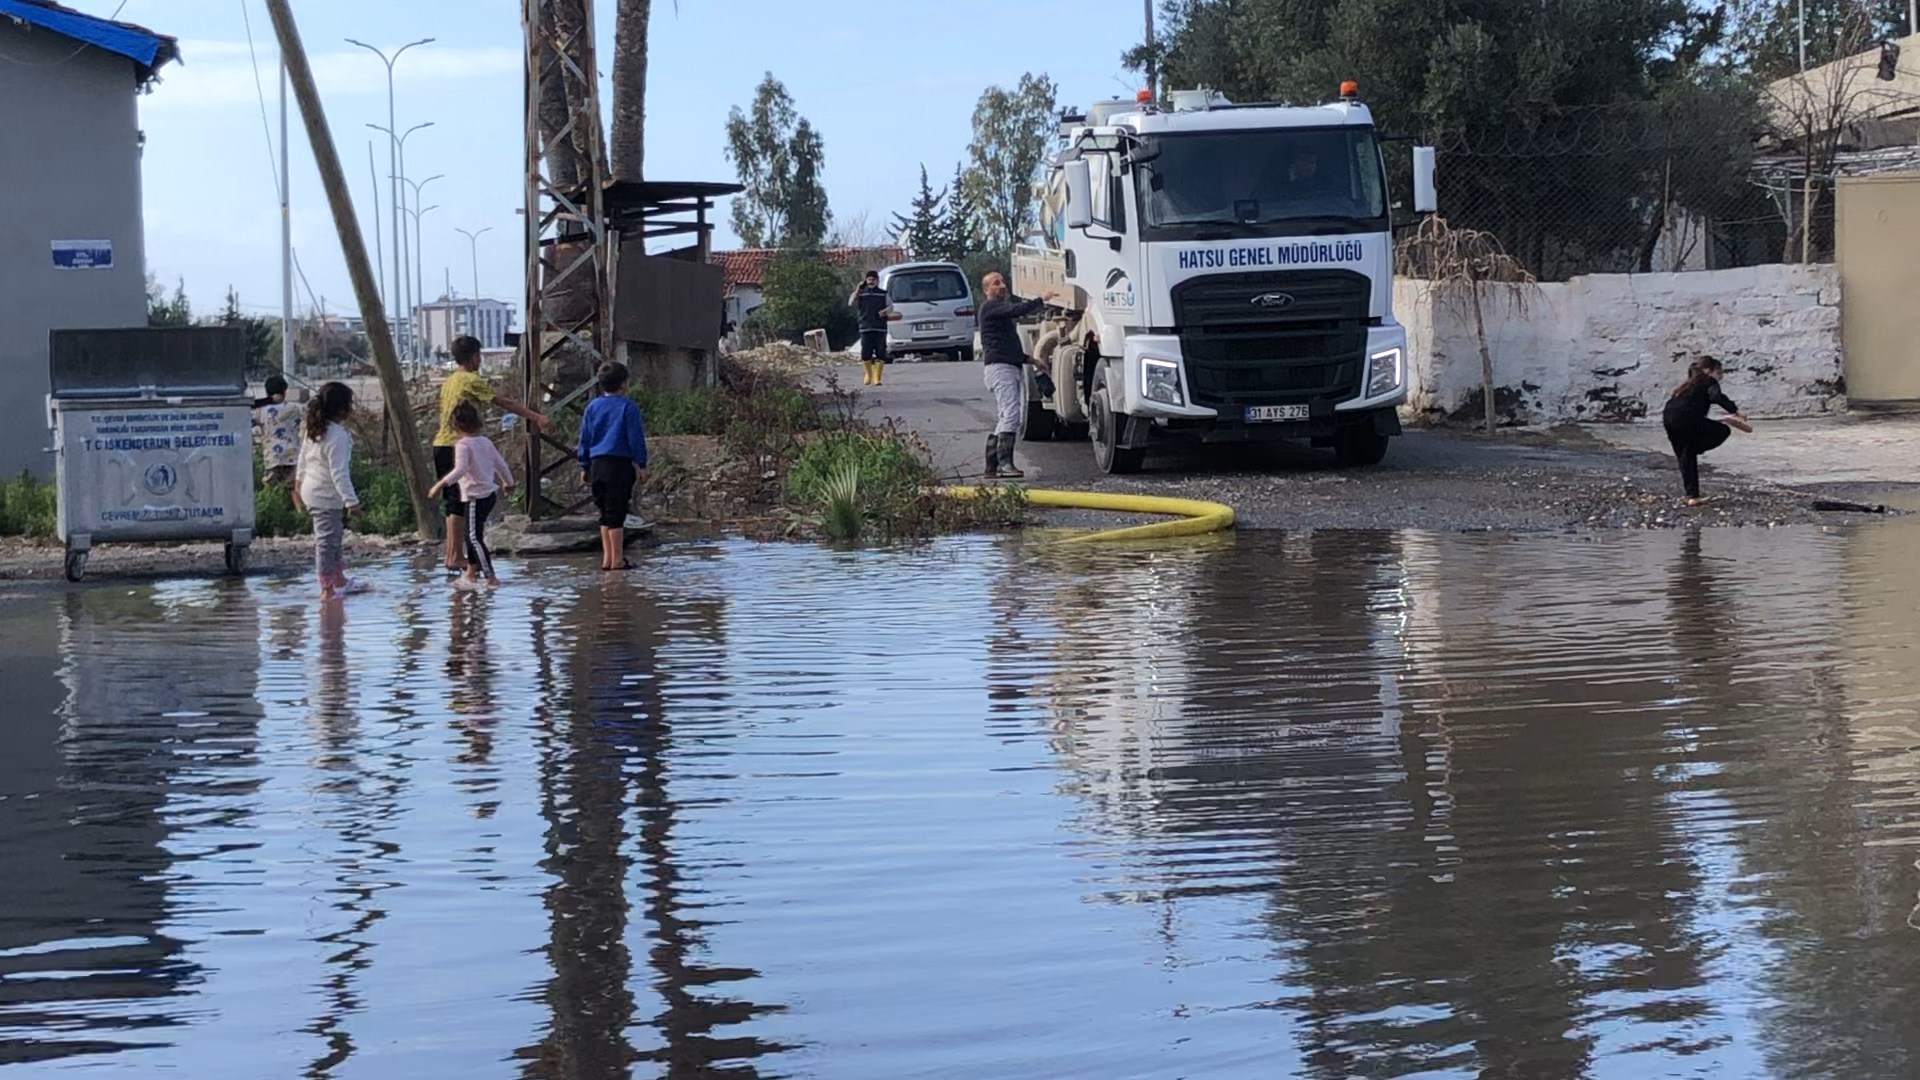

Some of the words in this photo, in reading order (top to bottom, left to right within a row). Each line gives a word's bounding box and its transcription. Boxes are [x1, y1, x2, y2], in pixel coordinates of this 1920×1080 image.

[1179, 249, 1224, 269] HATSU
[1229, 246, 1273, 267] GENEL
[1278, 240, 1363, 265] MÜDÜRLÜĞÜ
[1251, 408, 1262, 419] 31
[1266, 407, 1286, 418] AYS
[1289, 406, 1308, 417] 276
